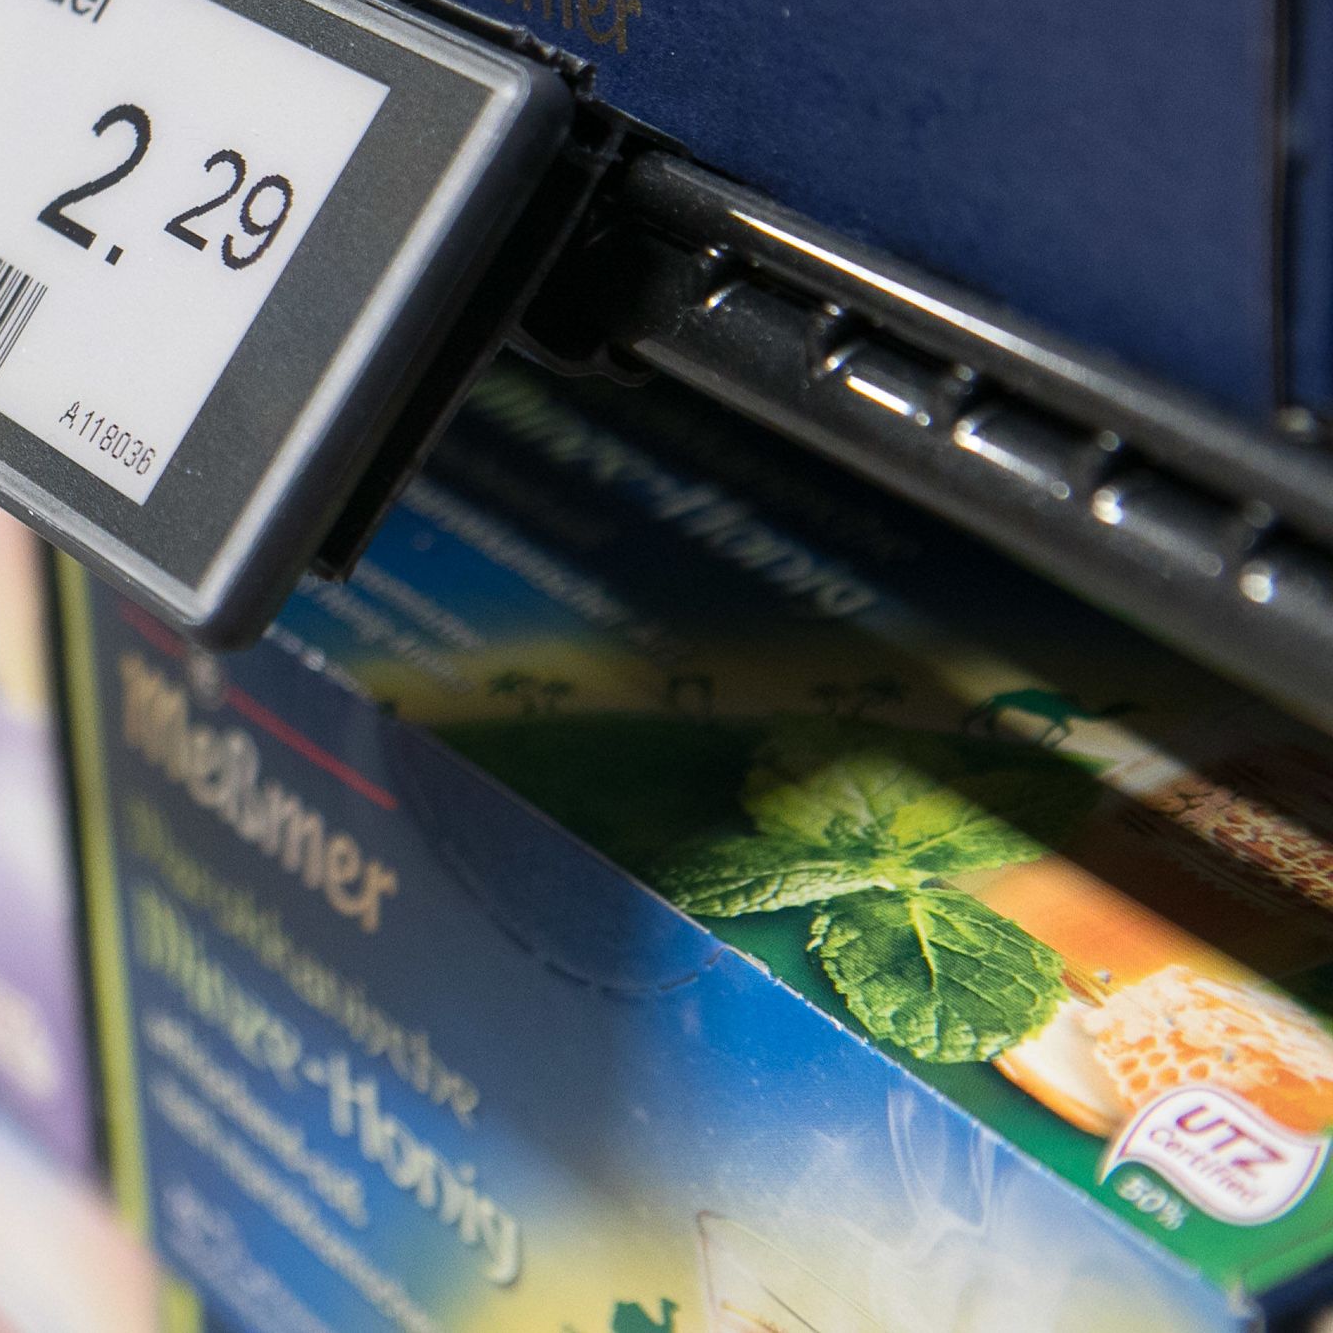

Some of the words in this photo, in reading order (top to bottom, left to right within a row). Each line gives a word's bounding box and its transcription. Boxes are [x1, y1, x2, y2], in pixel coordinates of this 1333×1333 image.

[59, 401, 156, 475] A118036
[1148, 1127, 1263, 1204] Certified
[1175, 1104, 1289, 1178] UTZ
